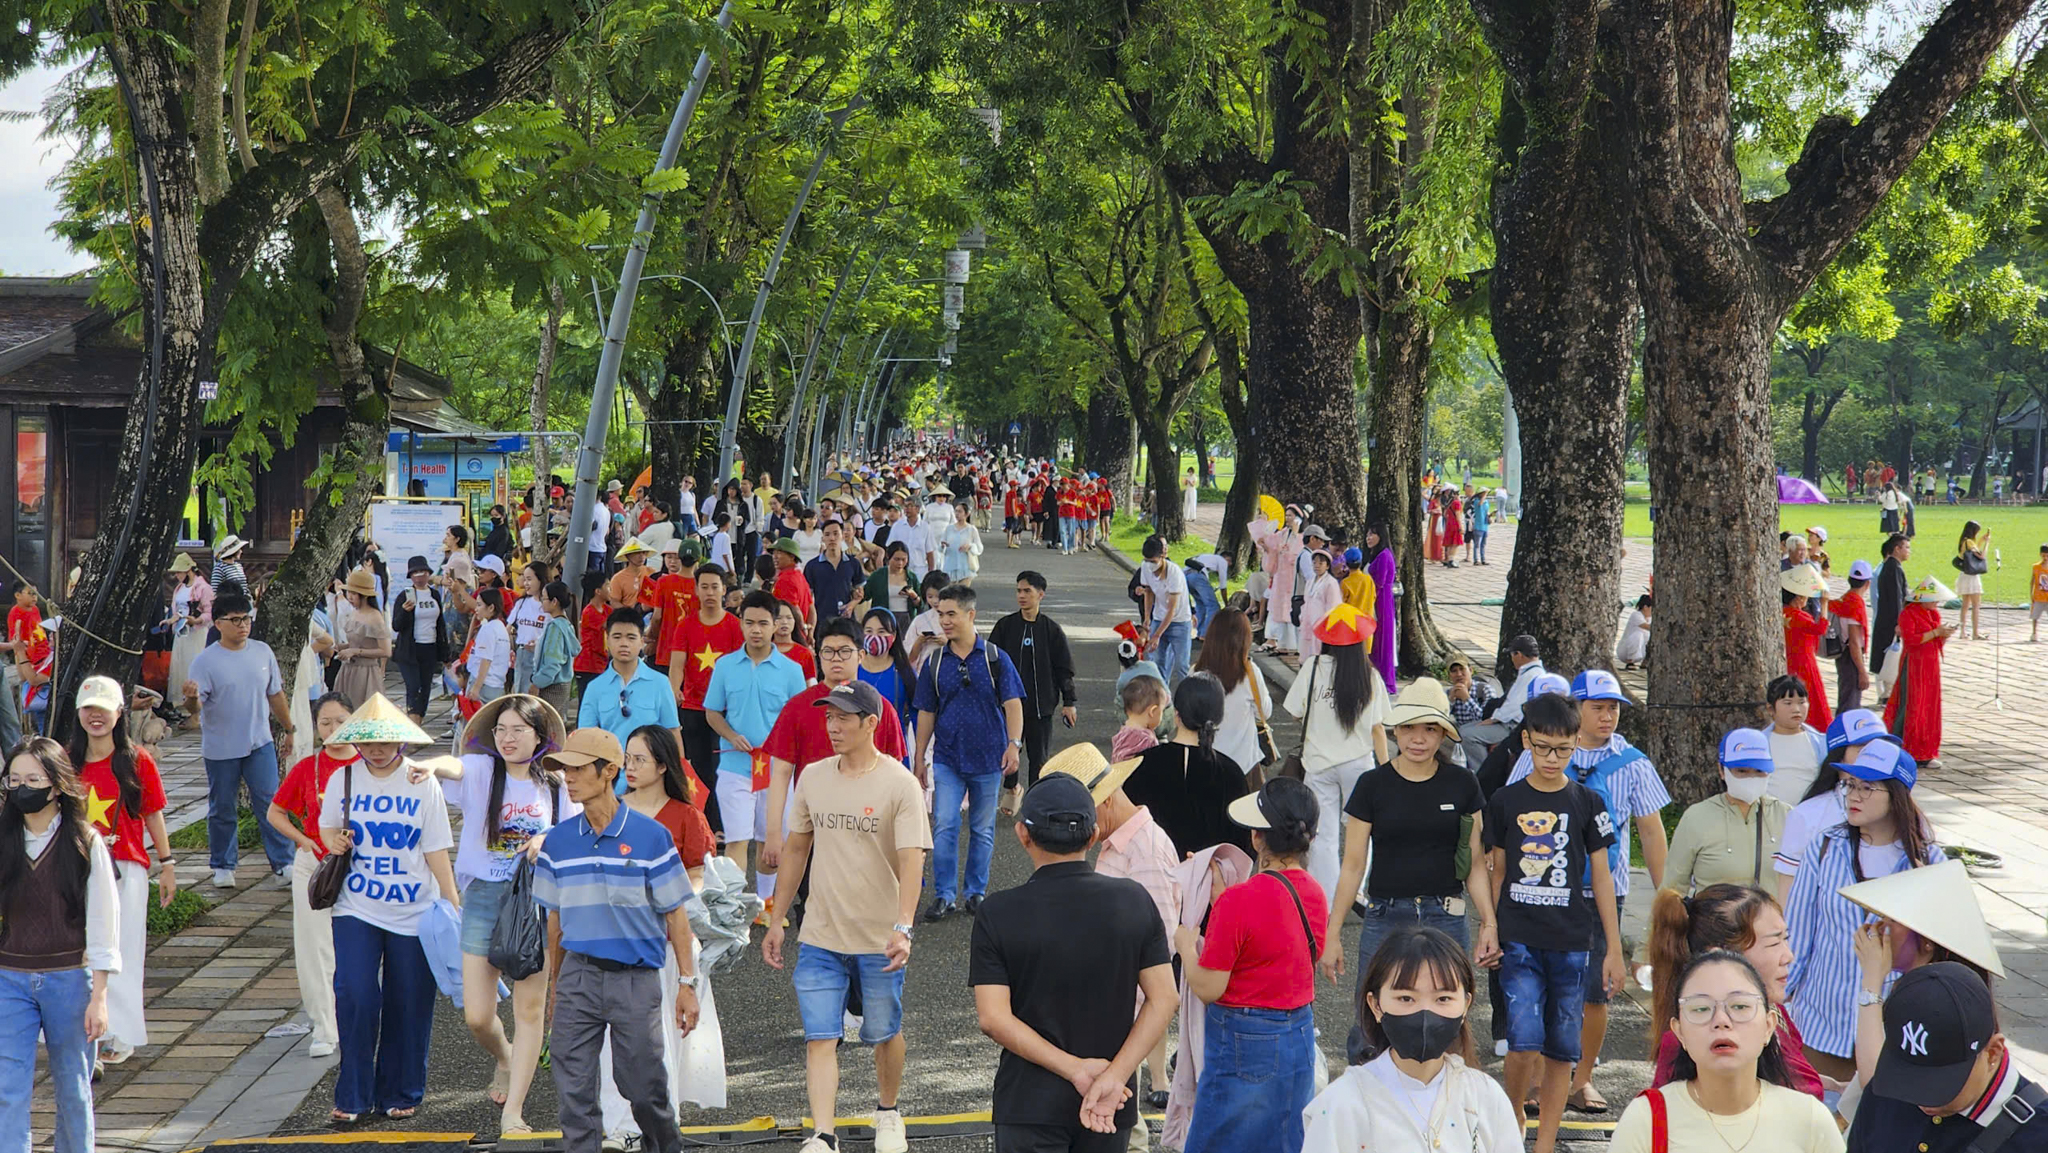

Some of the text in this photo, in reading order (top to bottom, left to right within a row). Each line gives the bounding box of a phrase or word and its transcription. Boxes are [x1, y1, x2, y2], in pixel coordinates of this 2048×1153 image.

[421, 463, 447, 475] Health
[827, 813, 879, 833] SITENCE
[347, 867, 421, 902] ODAY
